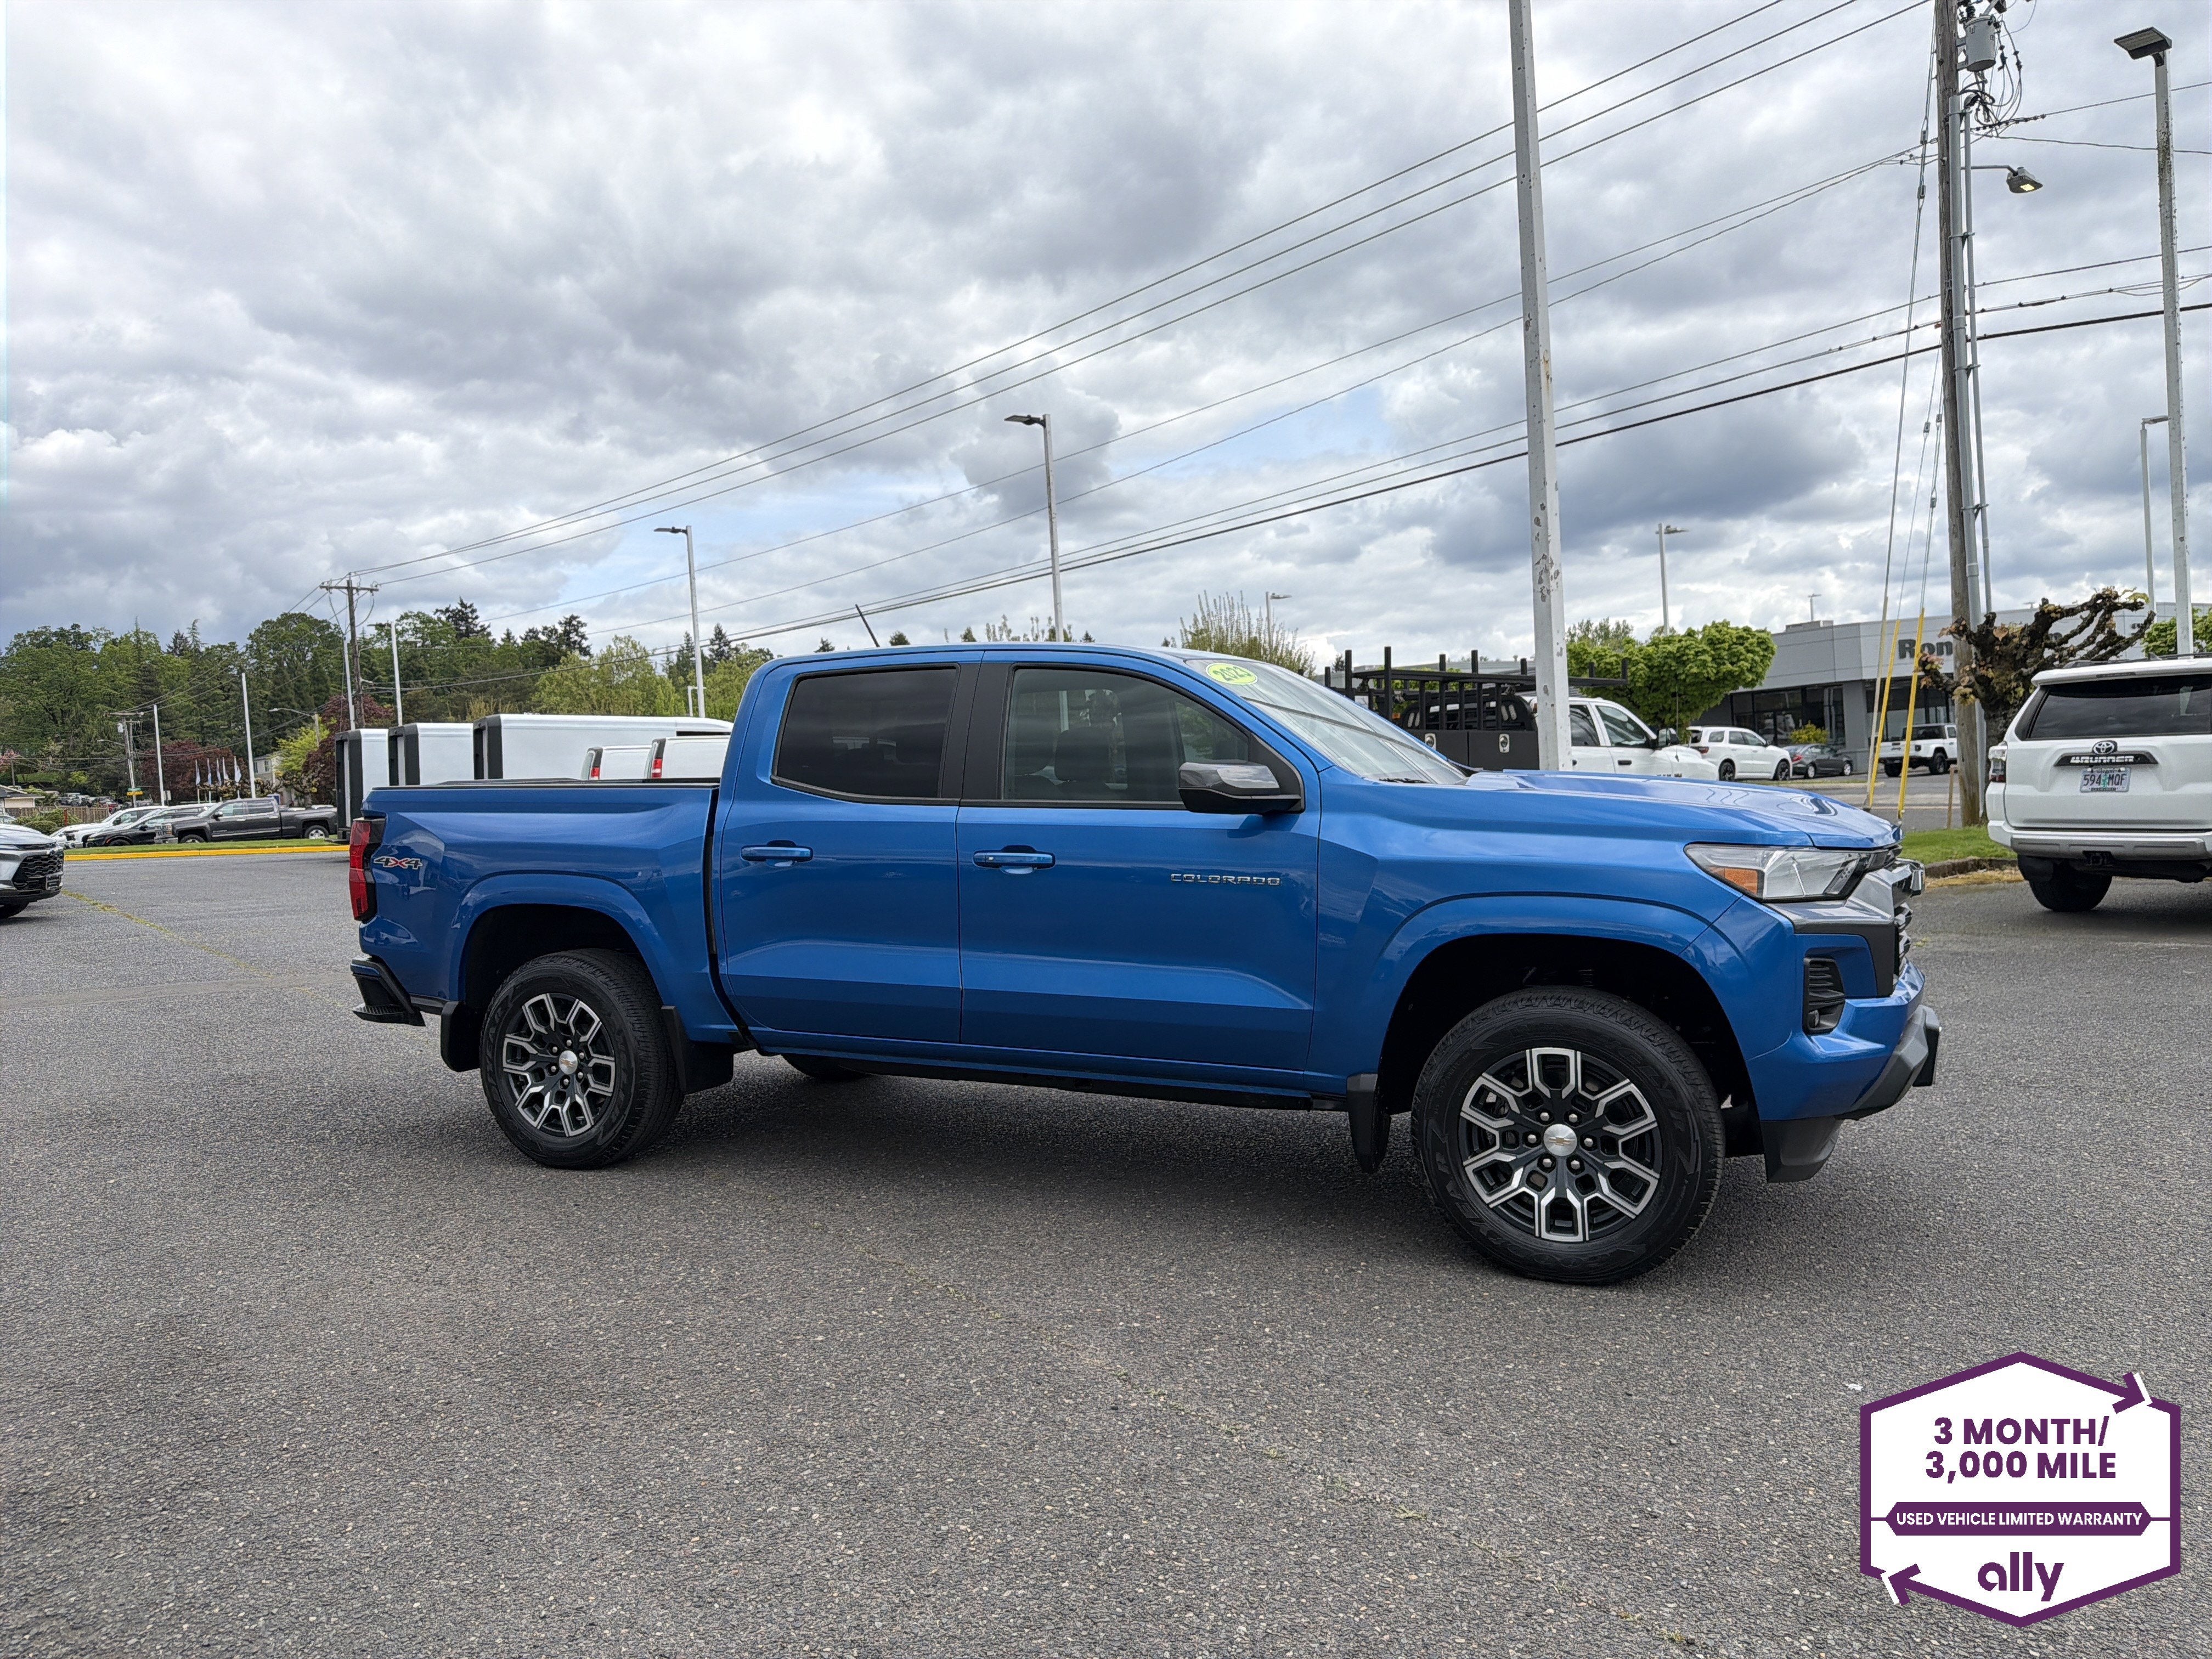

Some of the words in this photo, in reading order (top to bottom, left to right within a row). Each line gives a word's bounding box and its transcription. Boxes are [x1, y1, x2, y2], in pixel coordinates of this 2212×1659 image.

[1898, 639, 1953, 659] Ron
[1212, 665, 1252, 681] 2023
[2083, 774, 2102, 787] 594
[1171, 873, 1280, 886] COLORADO
